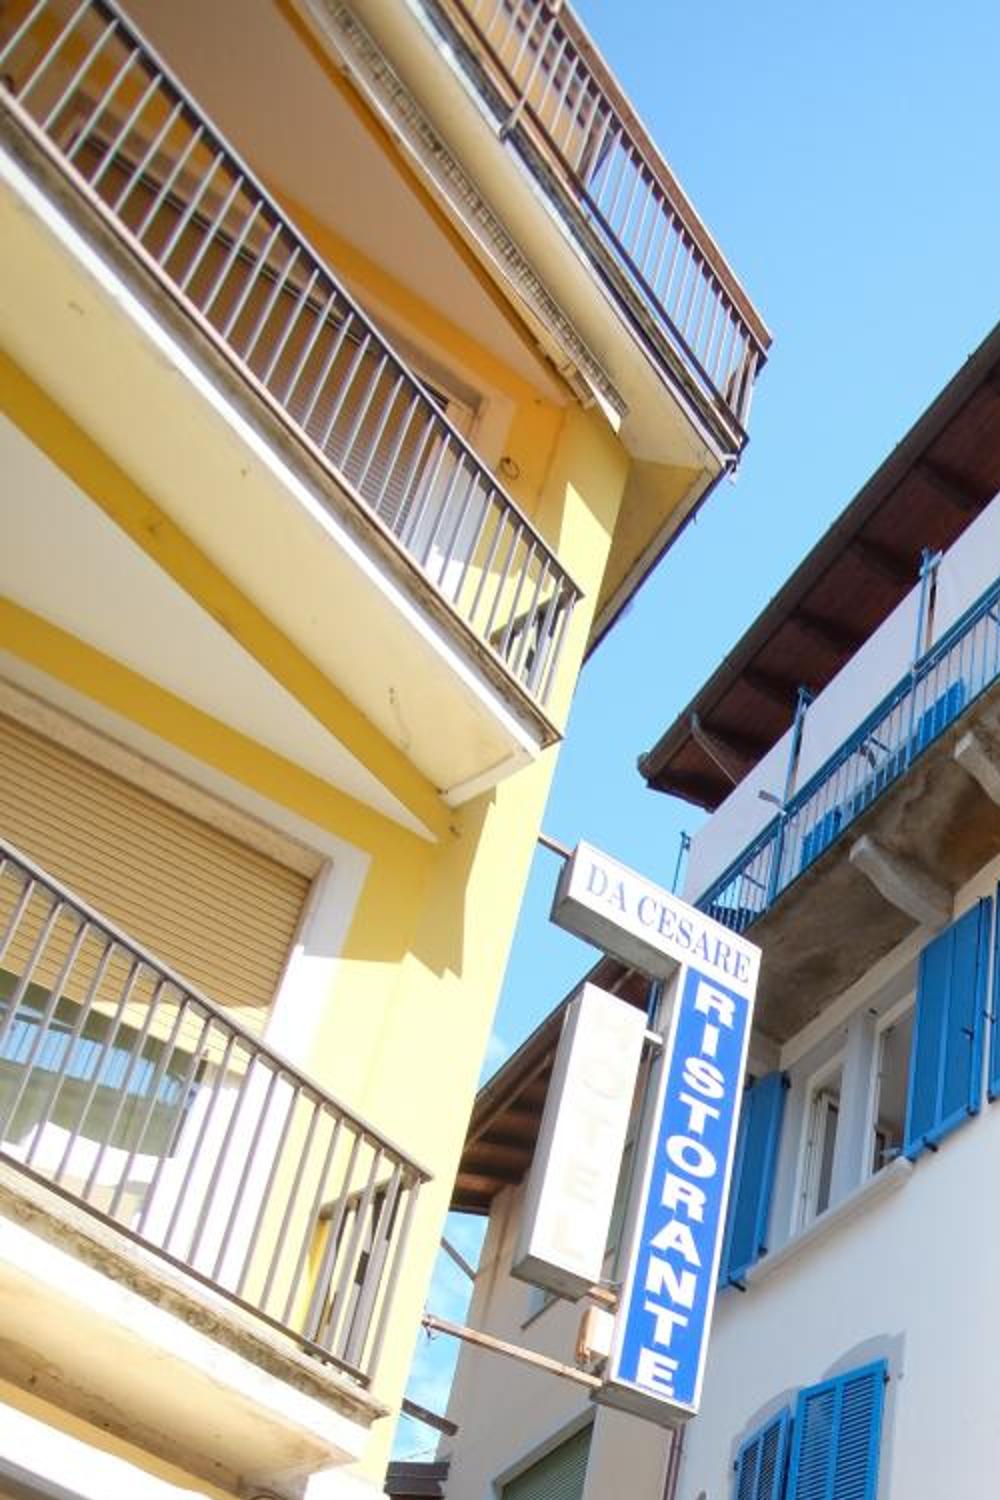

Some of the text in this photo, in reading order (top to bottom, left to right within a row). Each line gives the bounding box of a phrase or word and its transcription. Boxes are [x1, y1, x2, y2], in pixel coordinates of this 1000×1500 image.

[586, 863, 752, 984] DA CESARE
[635, 981, 736, 1398] RISTORANTE
